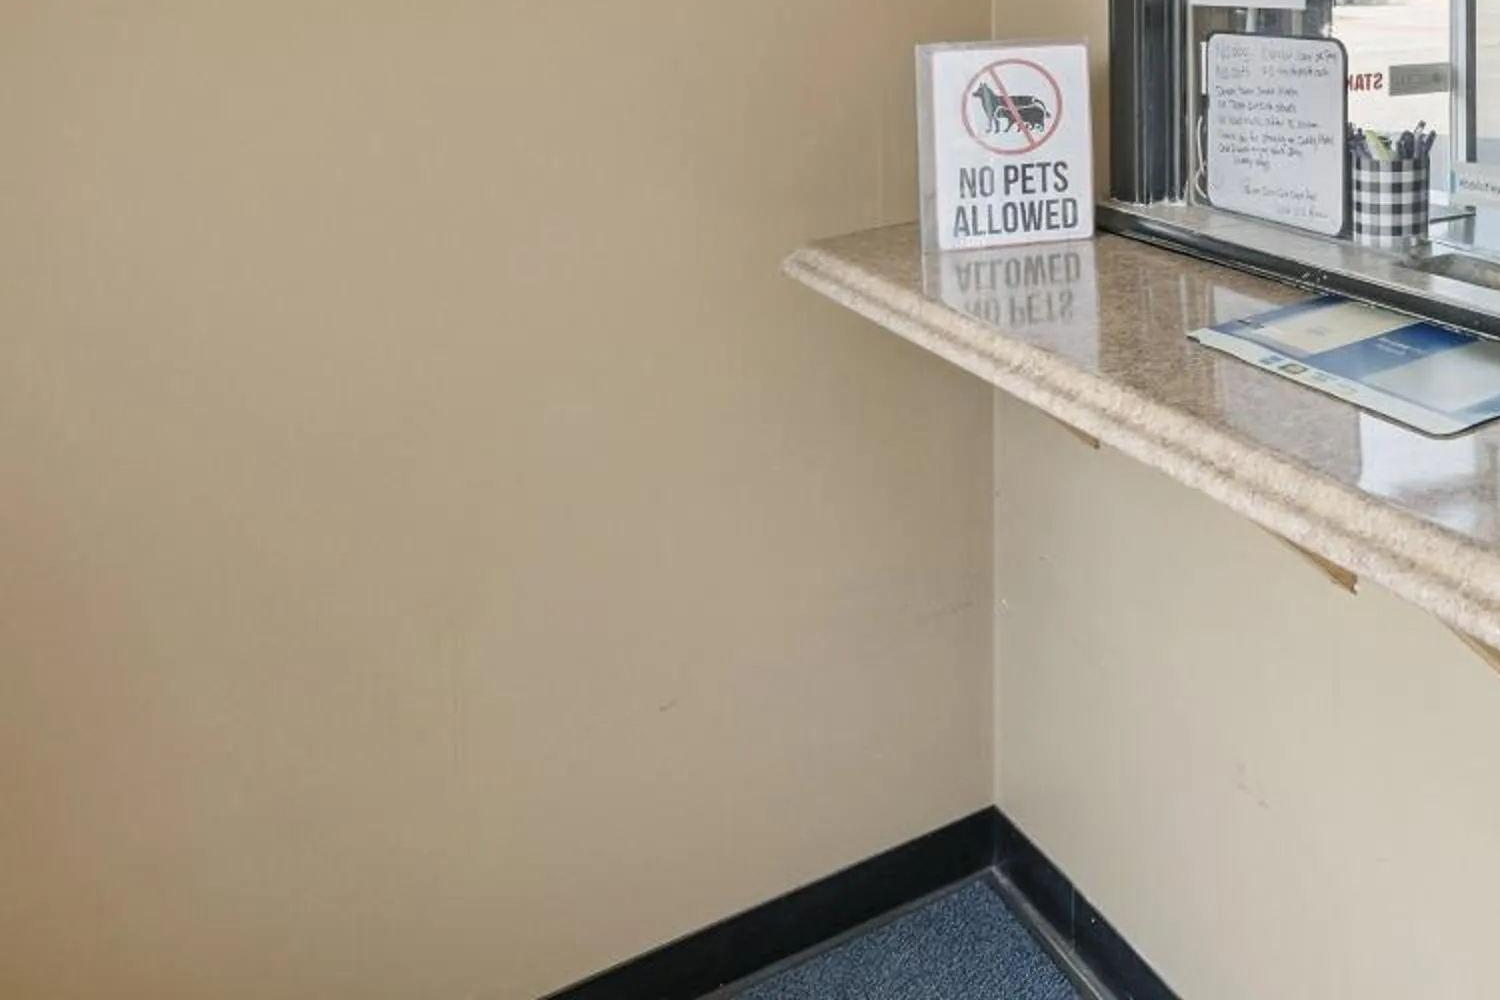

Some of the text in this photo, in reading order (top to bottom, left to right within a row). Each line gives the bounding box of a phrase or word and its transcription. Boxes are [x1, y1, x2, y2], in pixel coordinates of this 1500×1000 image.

[959, 161, 1069, 199] NO PETS
[953, 197, 1079, 237] ALLOWED
